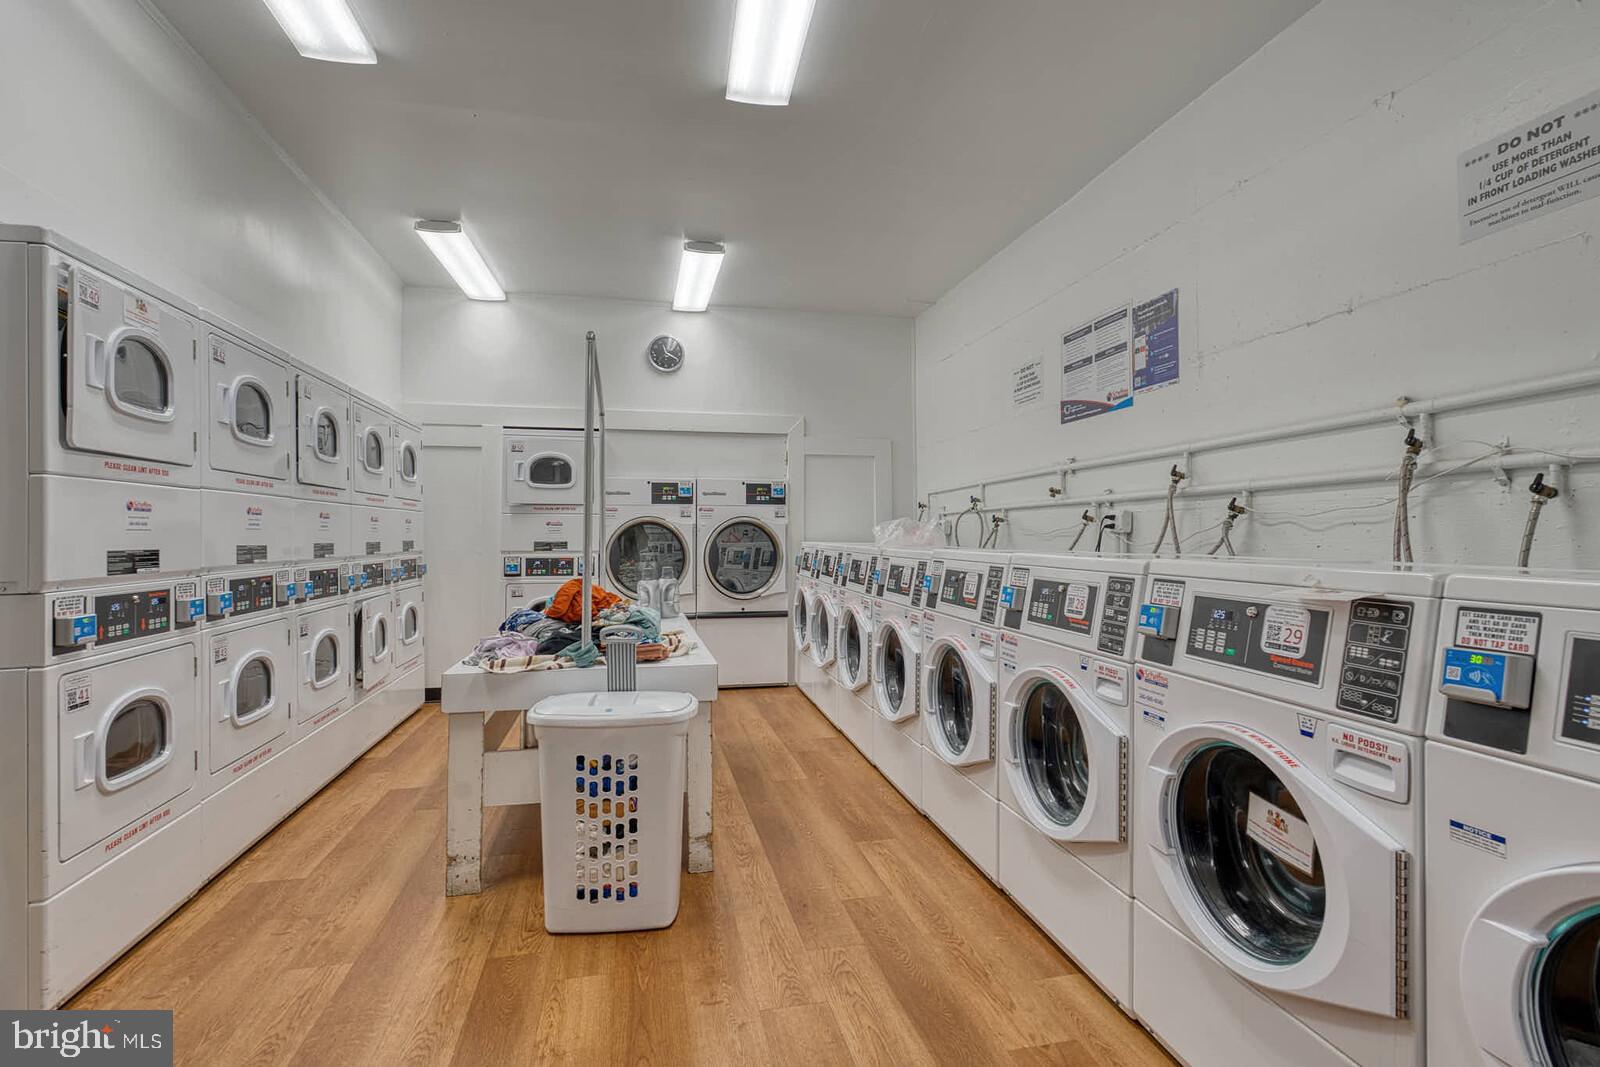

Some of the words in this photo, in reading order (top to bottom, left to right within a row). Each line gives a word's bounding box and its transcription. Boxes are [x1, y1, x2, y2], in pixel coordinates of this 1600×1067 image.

[1497, 136, 1521, 155] DO
[1527, 115, 1565, 141] NOT
[1492, 159, 1509, 172] USE
[1512, 146, 1539, 164] MORE
[1541, 131, 1572, 151] THAN
[1479, 178, 1492, 190] 1/4
[1495, 169, 1514, 182] CUP
[1517, 162, 1529, 173] OF
[1531, 136, 1590, 167] DETERGENT
[1468, 196, 1477, 206] IN
[1480, 182, 1510, 201] FRONT
[1513, 164, 1557, 188] LOADING
[89, 288, 100, 304] 40
[1075, 598, 1085, 610] 28
[1284, 628, 1303, 645] 29
[1508, 642, 1529, 652] CARD
[78, 688, 89, 701] 41
[1343, 732, 1354, 742] NO
[1358, 737, 1388, 753] PODS!!
[1274, 751, 1300, 768] DONE
[1463, 824, 1491, 839] NOTICE
